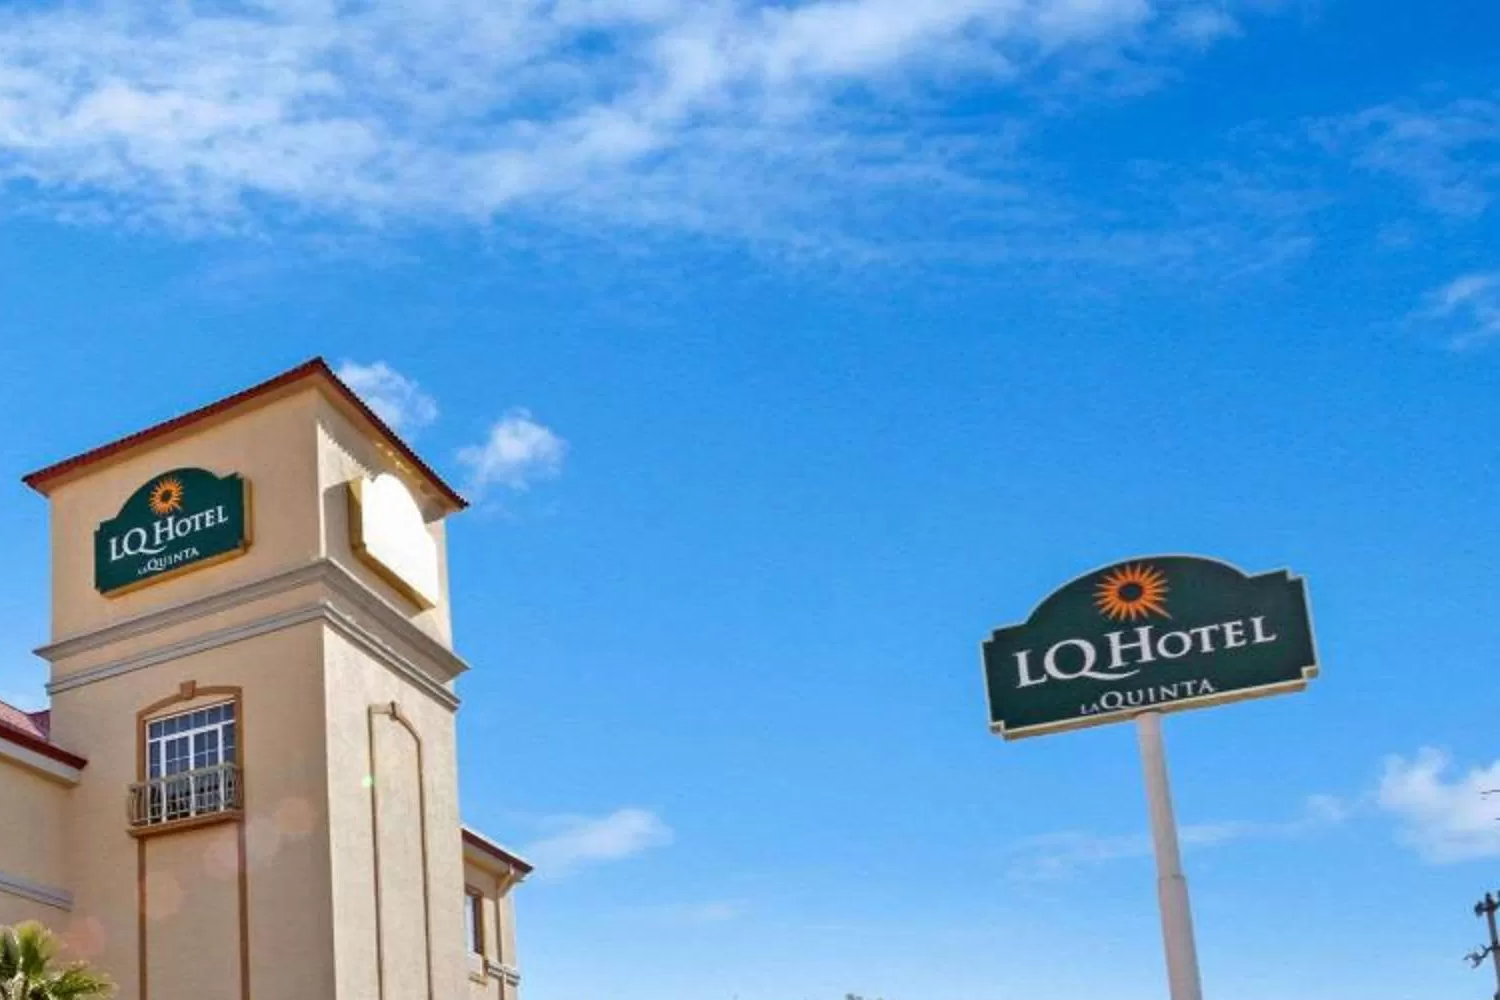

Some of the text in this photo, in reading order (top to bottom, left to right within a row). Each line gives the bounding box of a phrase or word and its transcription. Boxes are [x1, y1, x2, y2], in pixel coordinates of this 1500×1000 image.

[109, 505, 229, 561] LQ HOTEL
[1012, 616, 1277, 688] LQ HOTEL
